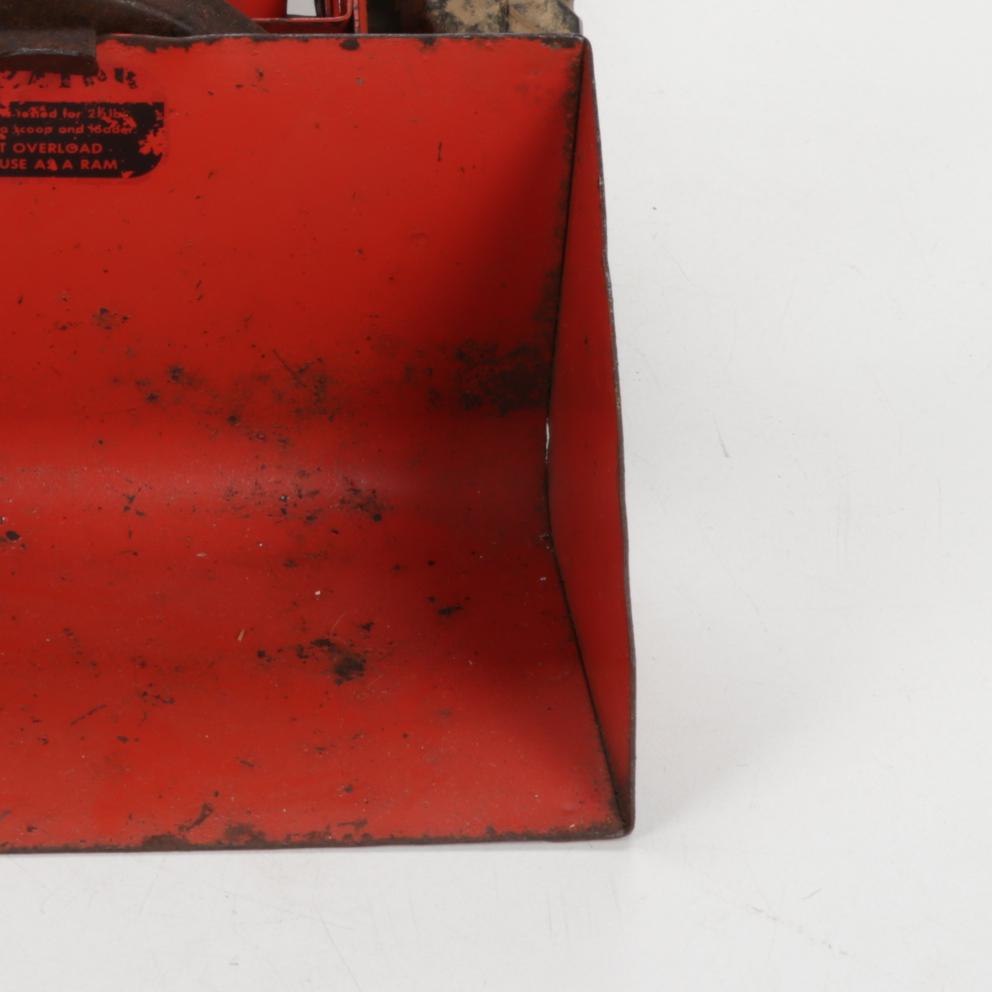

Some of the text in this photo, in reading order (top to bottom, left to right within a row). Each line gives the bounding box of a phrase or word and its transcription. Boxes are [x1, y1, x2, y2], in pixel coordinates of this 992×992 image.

[63, 108, 82, 118] for
[58, 124, 85, 135] and
[12, 142, 104, 154] OVERLOAD
[62, 160, 74, 170] A
[80, 159, 119, 170] RAM
